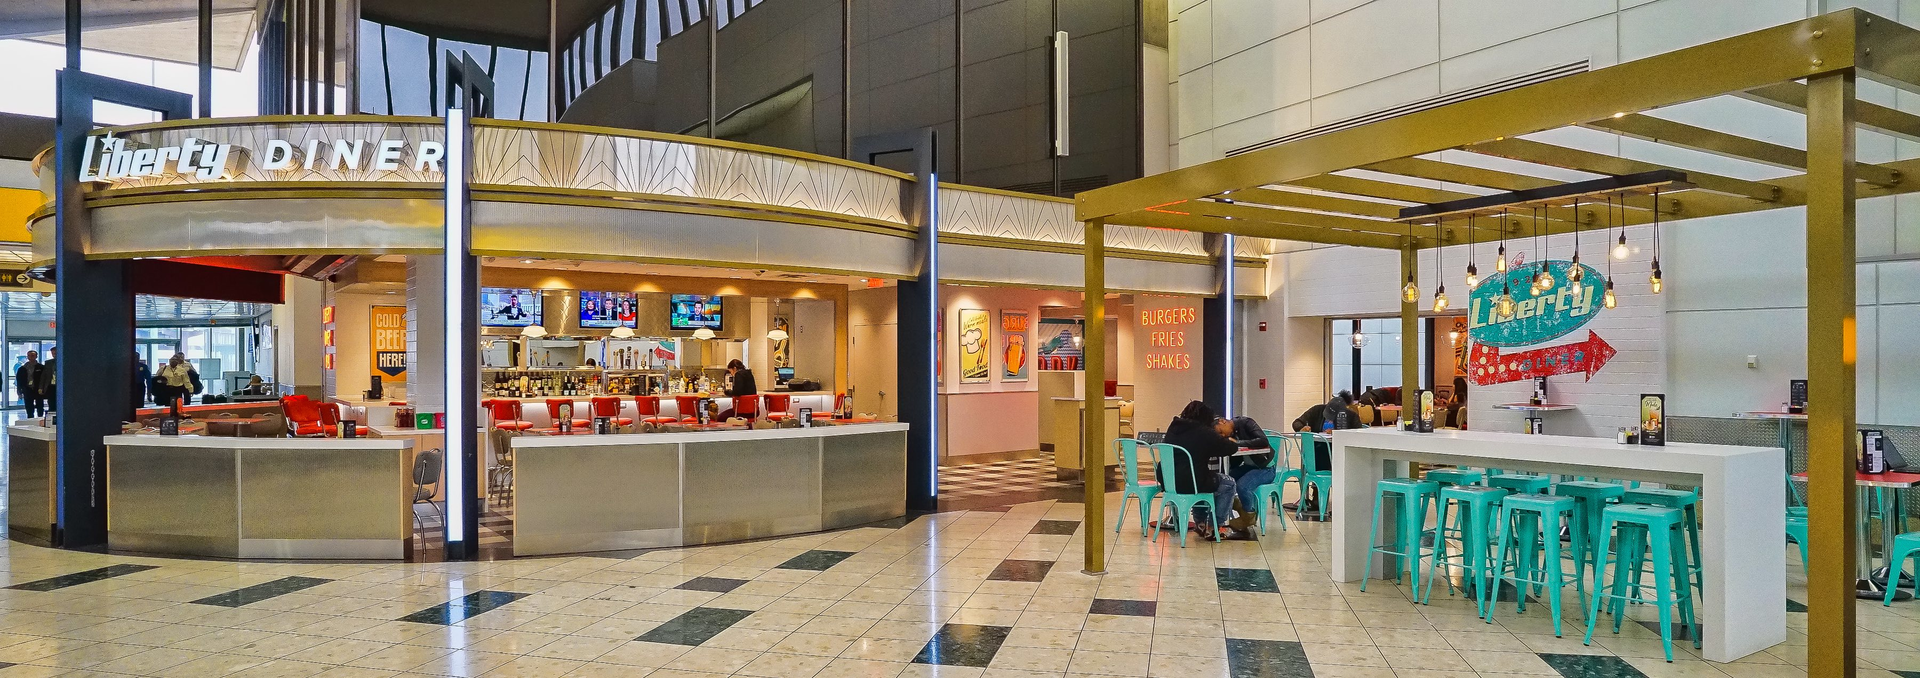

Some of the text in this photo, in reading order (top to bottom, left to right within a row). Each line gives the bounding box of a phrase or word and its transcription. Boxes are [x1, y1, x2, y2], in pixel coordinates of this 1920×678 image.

[79, 131, 444, 182] Liberty DINER
[376, 313, 400, 328] COLD
[1142, 307, 1195, 326] BURGERS
[1151, 331, 1184, 347] FRIES
[379, 353, 407, 368] HERE!
[1146, 353, 1190, 370] SHAKES
[1521, 351, 1584, 371] DINER
